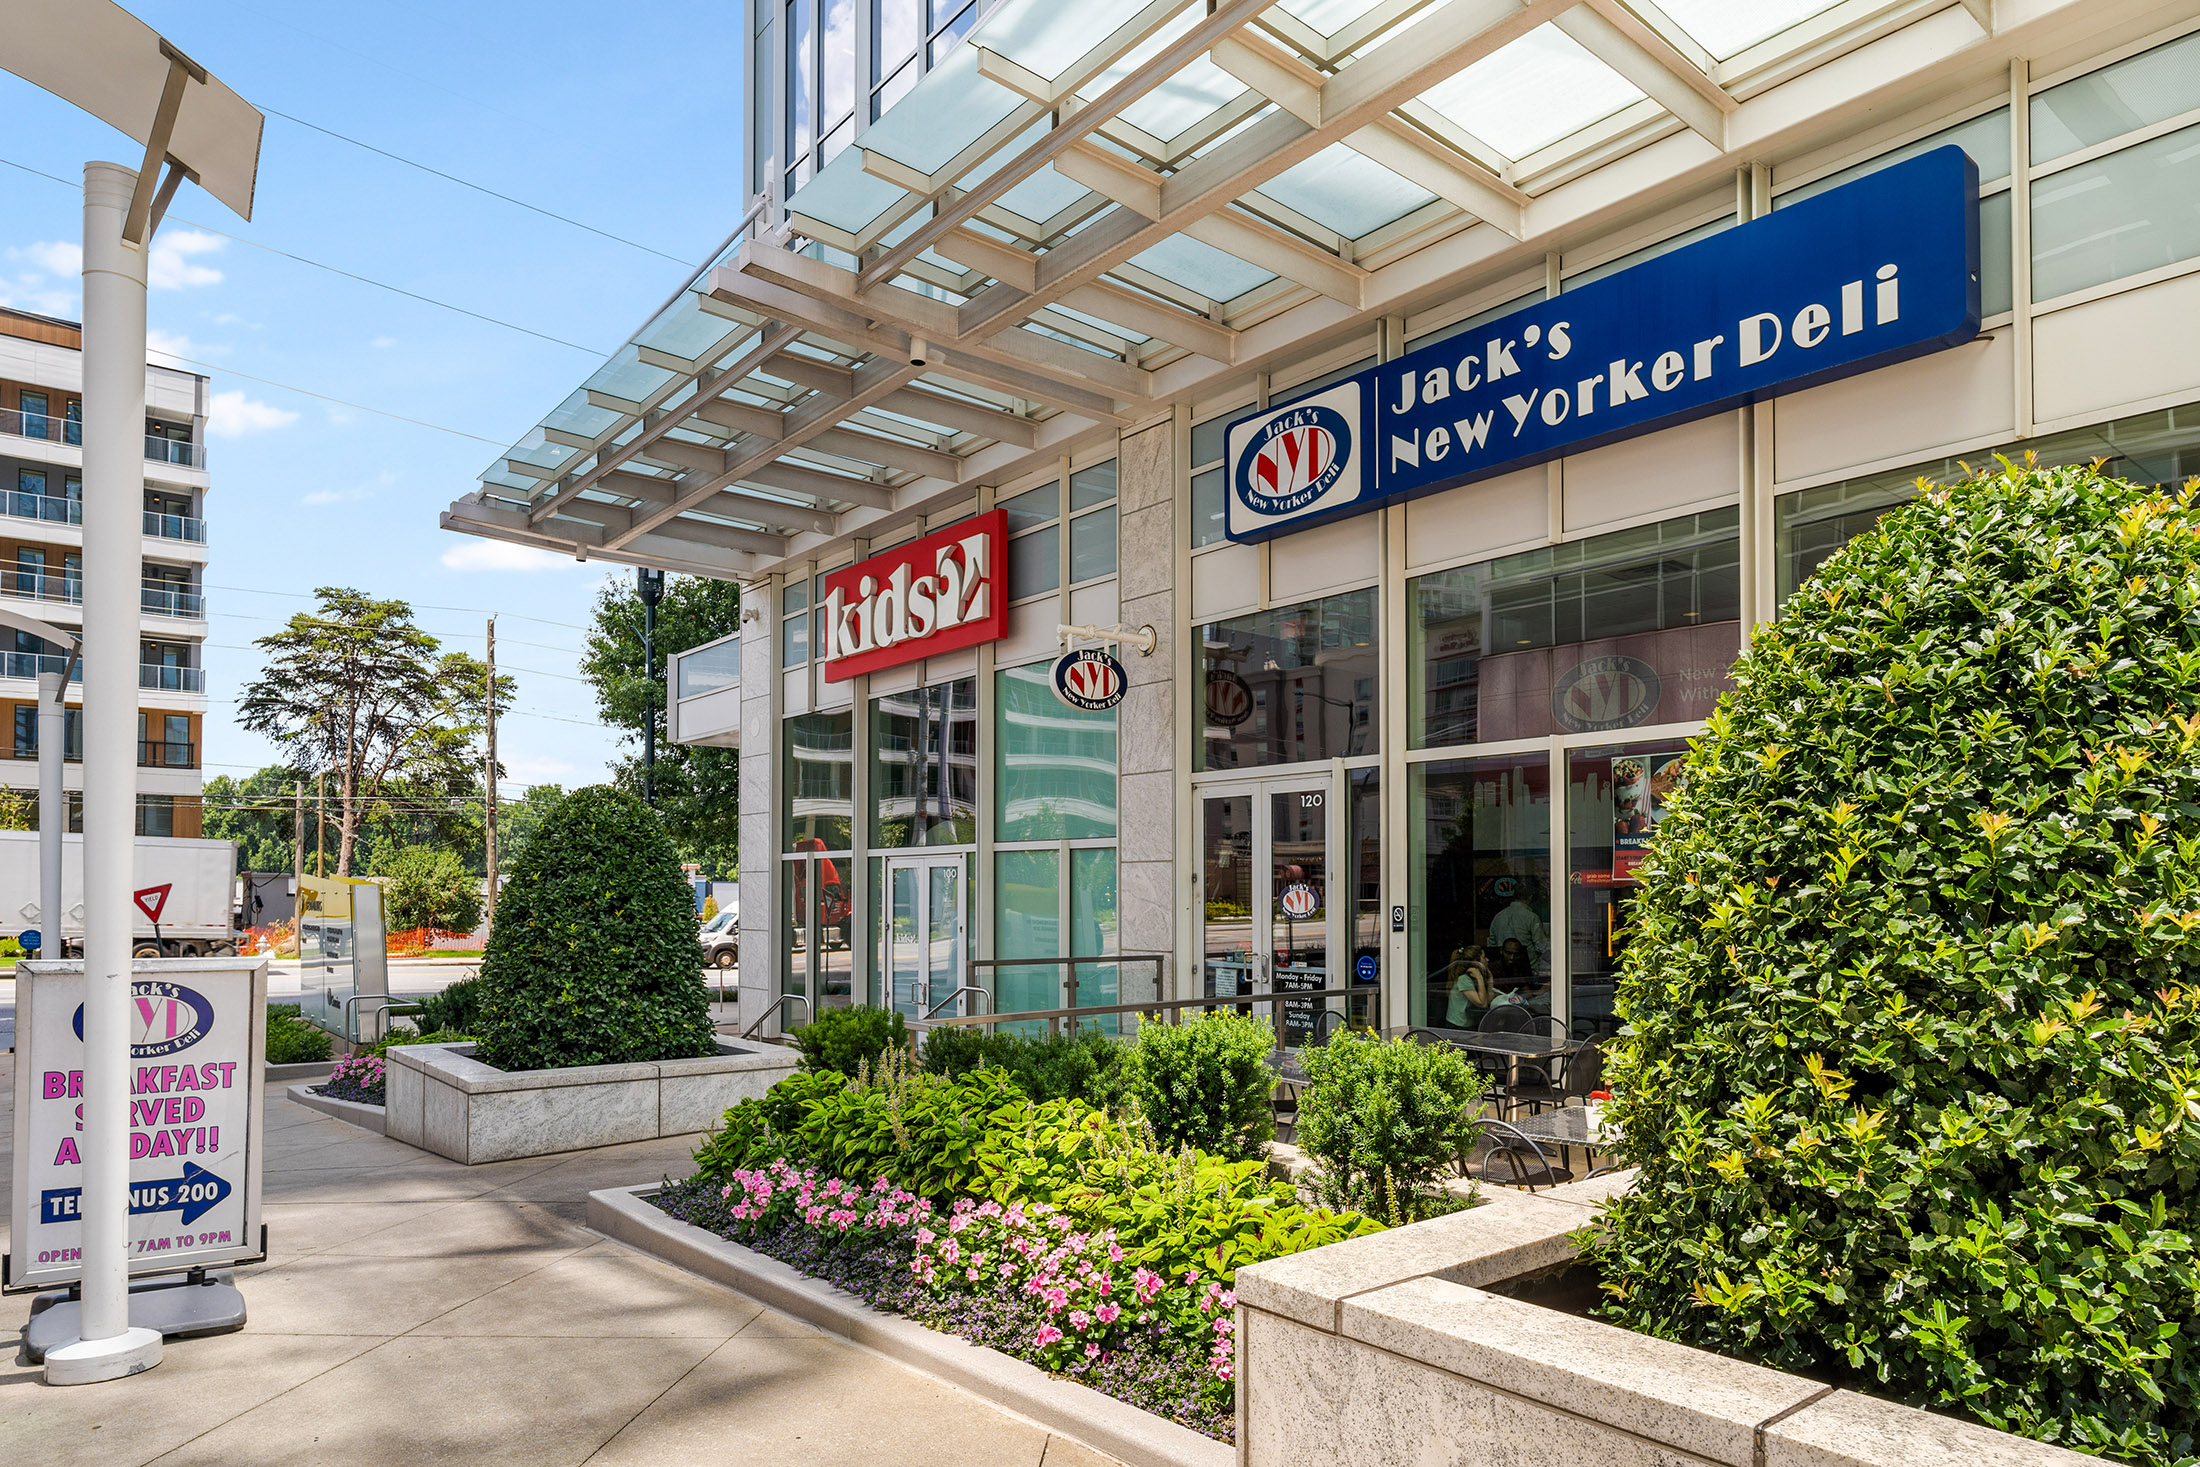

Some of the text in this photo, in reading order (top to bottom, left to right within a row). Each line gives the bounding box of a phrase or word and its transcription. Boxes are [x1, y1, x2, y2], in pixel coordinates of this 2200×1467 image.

[1391, 321, 1572, 415] Jack's
[1391, 263, 1899, 474] New Yorker Deli
[1263, 408, 1320, 441] Jack's
[1256, 427, 1331, 495] NYD
[1244, 462, 1340, 512] New Yorker Deli
[1077, 650, 1113, 667] Jack's
[1577, 656, 1631, 678] Jack's
[1069, 662, 1117, 699] NYD
[1679, 667, 1717, 682] New
[1062, 686, 1122, 710] New Yorker Deli
[1570, 671, 1640, 721] NYD
[1679, 685, 1720, 702] With
[1300, 794, 1323, 807] 120
[1619, 838, 1650, 846] BREAKF
[131, 982, 181, 998] ack's
[1276, 972, 1299, 981] Monday
[1303, 973, 1322, 983] Friday
[133, 997, 190, 1044] YD
[1288, 1011, 1310, 1021] Sunday
[131, 1028, 202, 1056] orker Deli
[43, 1062, 237, 1100] BRKFAST
[75, 1096, 206, 1133] RVED
[130, 1126, 220, 1160] DAY!!
[50, 1181, 219, 1216] TENUS 200
[137, 1237, 172, 1253] 7AM
[176, 1234, 195, 1248] TO
[199, 1230, 232, 1246] 9PM
